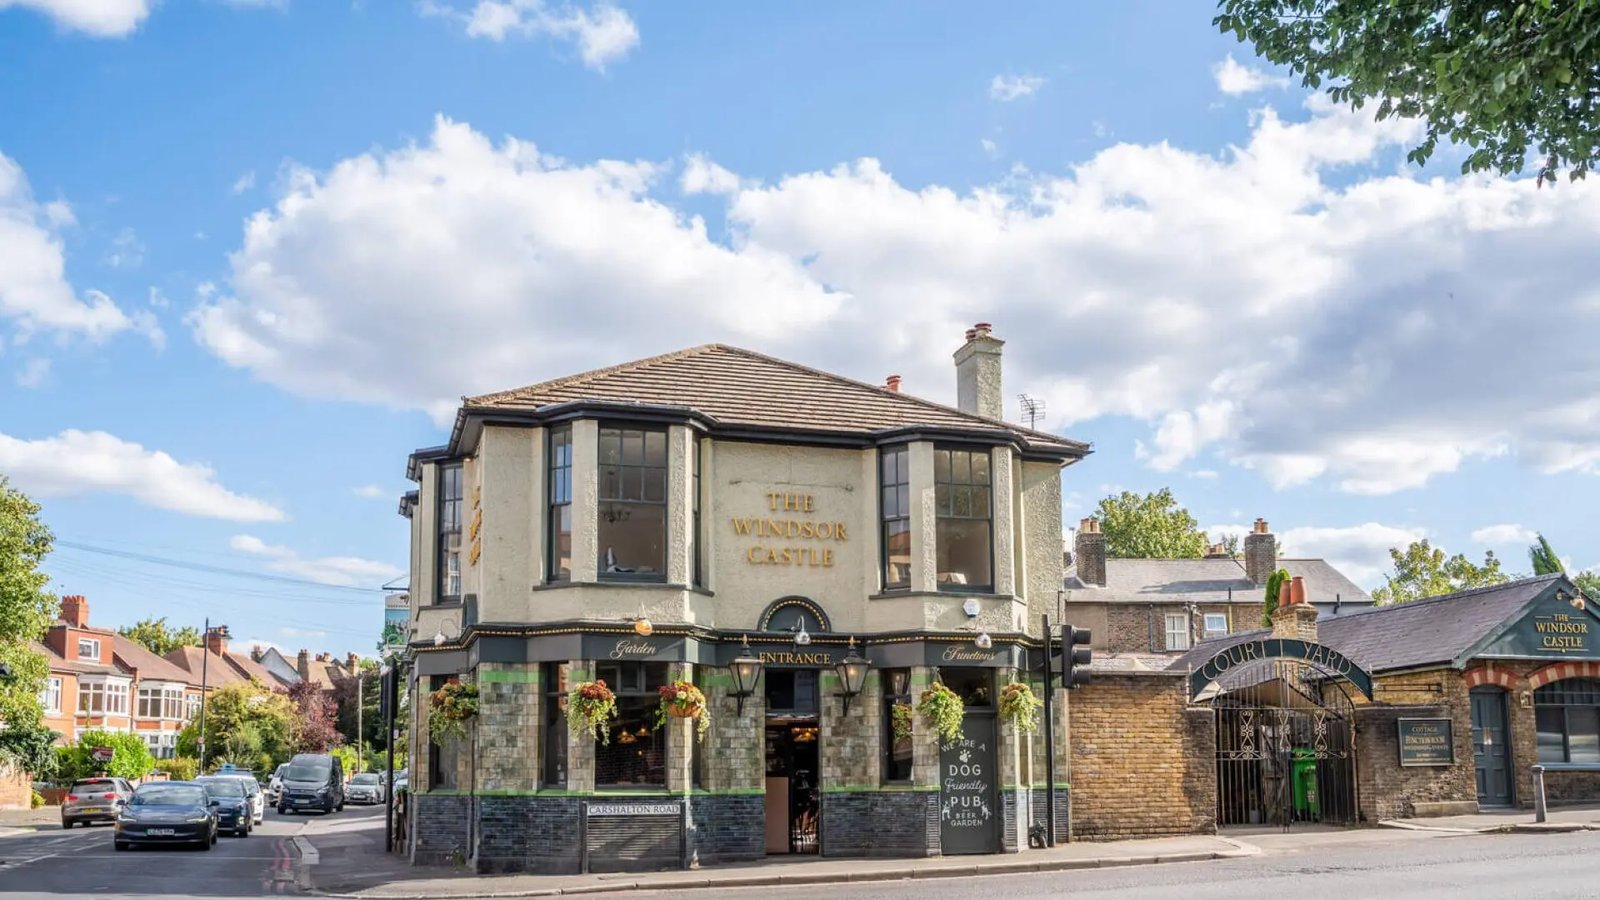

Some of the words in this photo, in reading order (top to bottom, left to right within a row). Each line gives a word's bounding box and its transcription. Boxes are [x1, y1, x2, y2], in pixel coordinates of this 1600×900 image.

[768, 491, 815, 513] THE
[732, 516, 848, 541] WINDSOR
[748, 545, 834, 567] CASTLE
[1554, 613, 1569, 622] THE
[1535, 622, 1588, 633] WINDSOR
[1543, 636, 1583, 647] CASTLE
[609, 640, 657, 660] Garden
[942, 645, 995, 661] Functions
[759, 651, 831, 665] ENTRANCE
[959, 739, 975, 748] ARE
[949, 764, 982, 776] DOG
[944, 778, 988, 793] Friendly
[950, 796, 981, 807] PUB
[589, 805, 652, 814] CARSHALTON
[653, 805, 679, 814] ROAD
[950, 819, 983, 827] GARDEN
